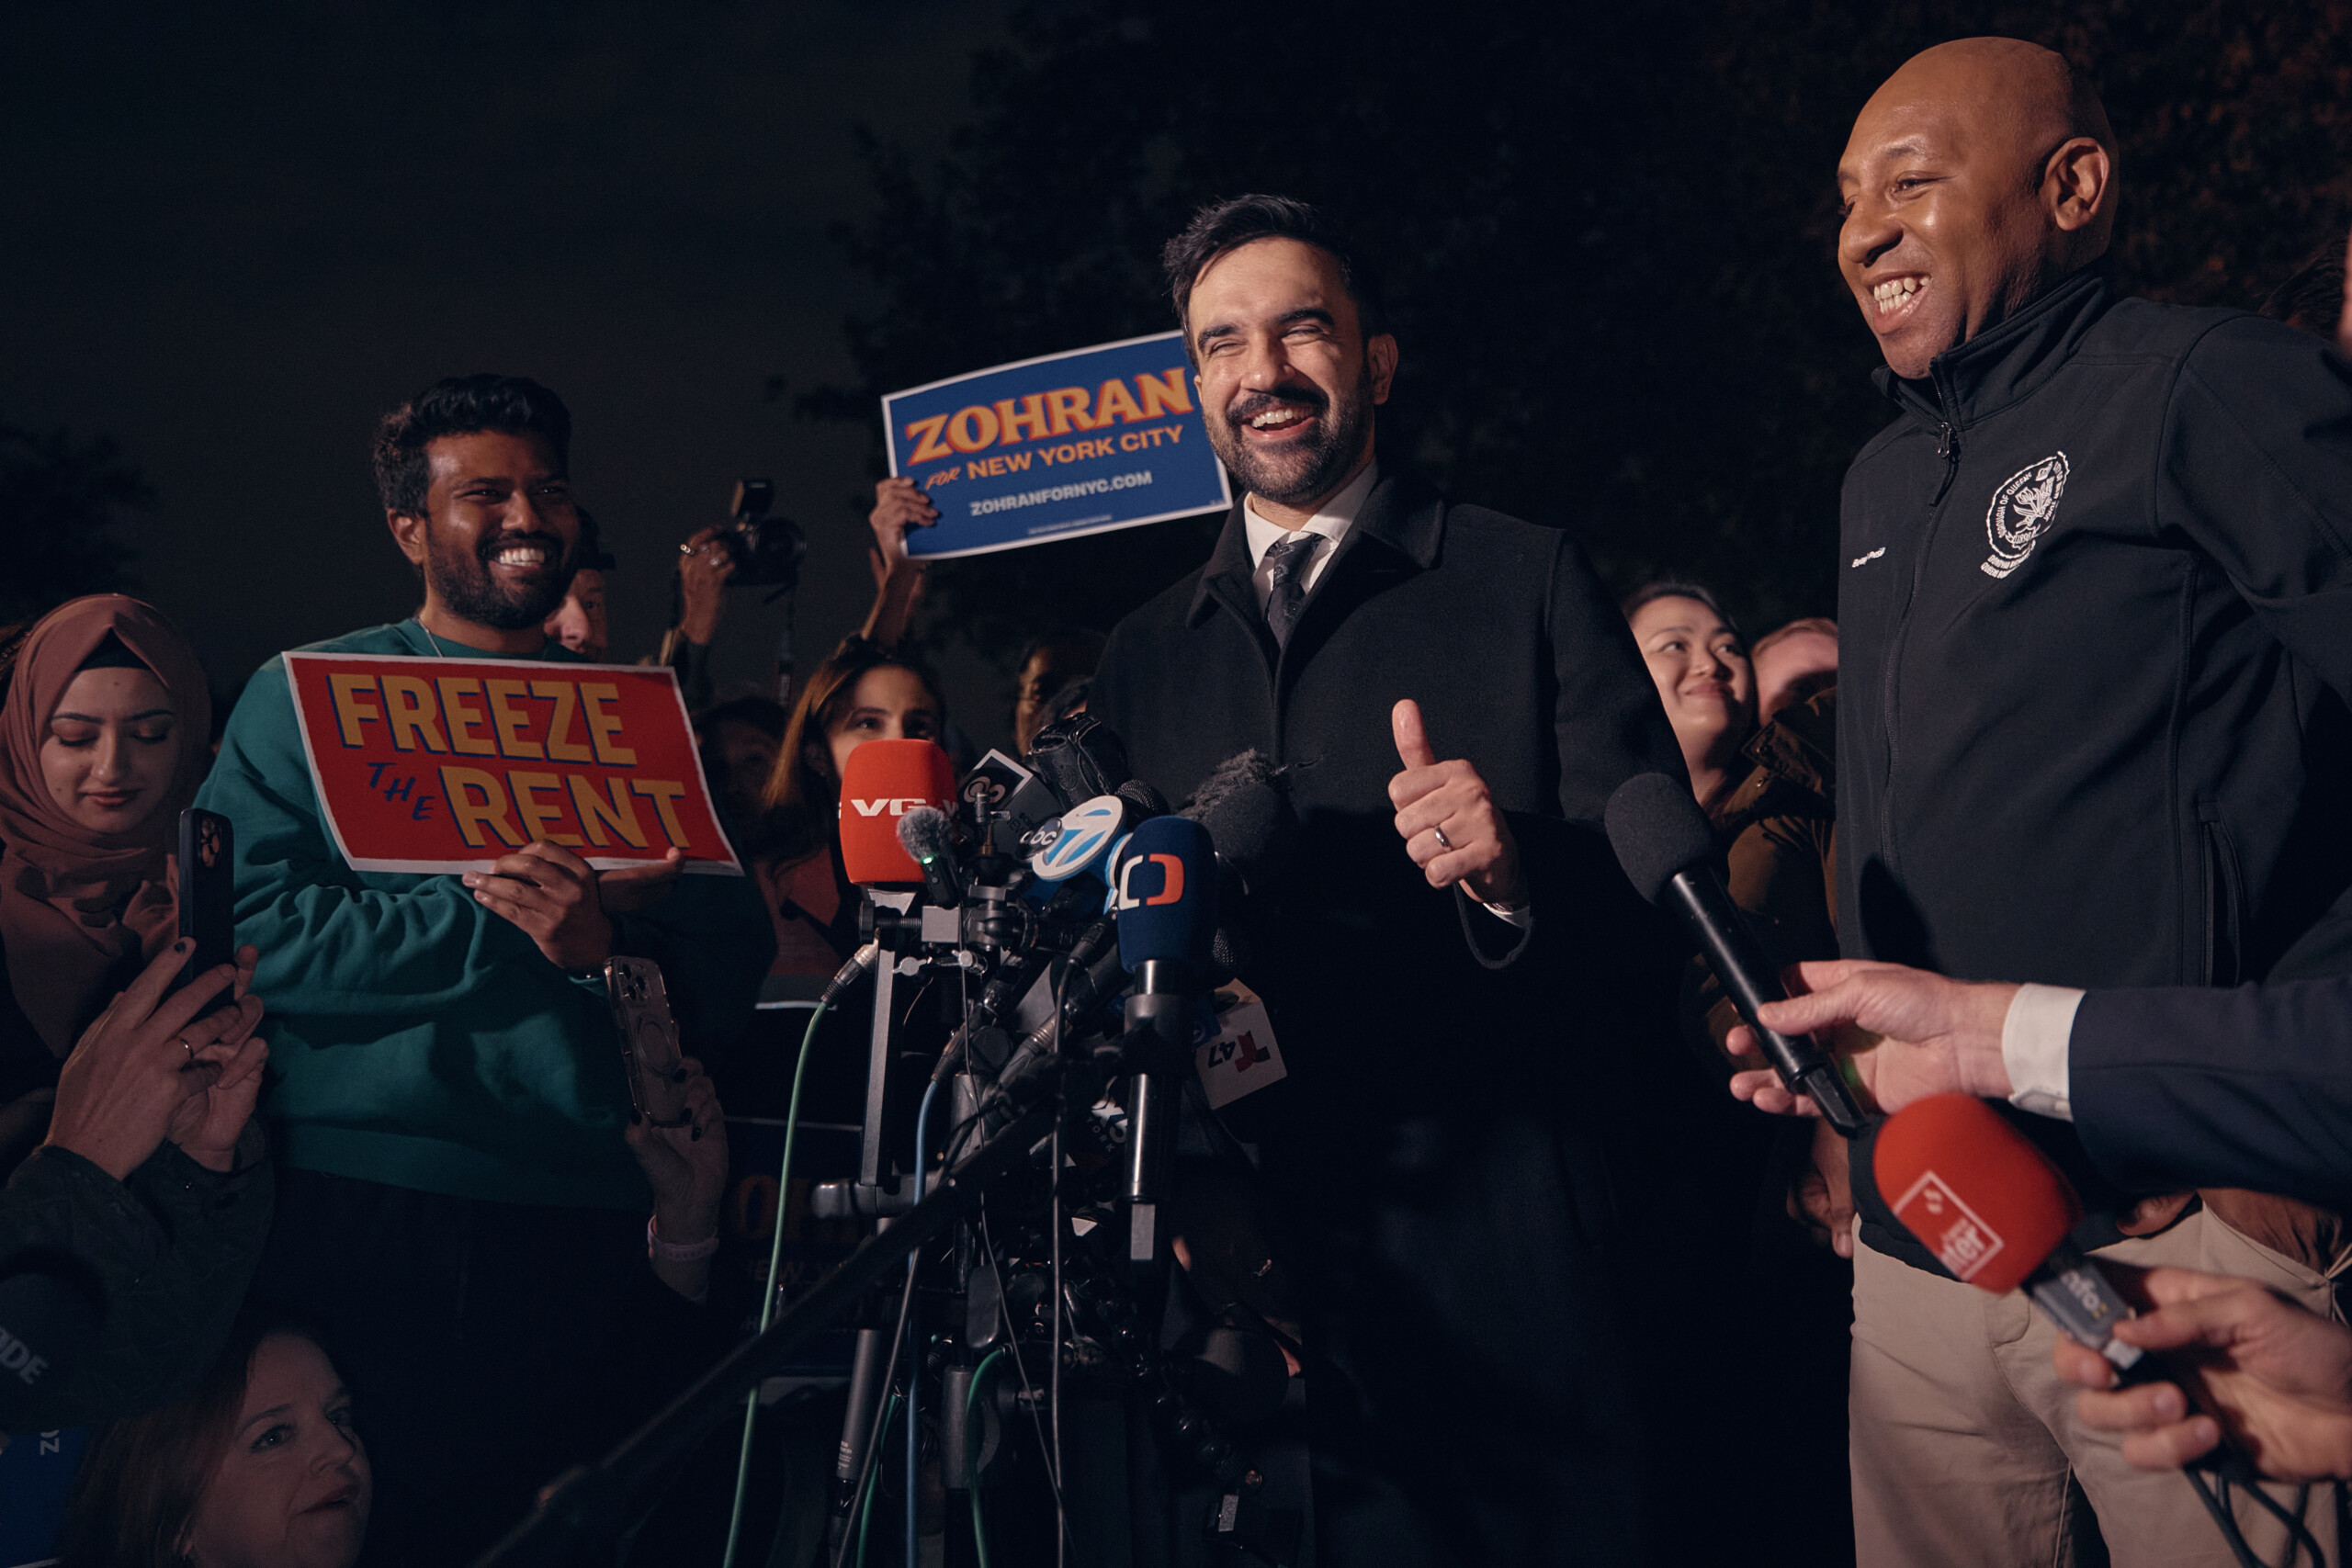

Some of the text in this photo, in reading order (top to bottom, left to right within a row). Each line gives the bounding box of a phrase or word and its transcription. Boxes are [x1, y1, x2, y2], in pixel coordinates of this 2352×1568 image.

[905, 367, 1195, 467] ZOHRAN
[924, 423, 1183, 491] FOR NEW YORK CITY
[969, 469, 1153, 516] ZOHRANFORNYC.COM
[327, 672, 638, 768] FREEZE
[368, 761, 435, 820] THE
[438, 764, 691, 849] RENT
[1207, 1041, 1236, 1069] 47
